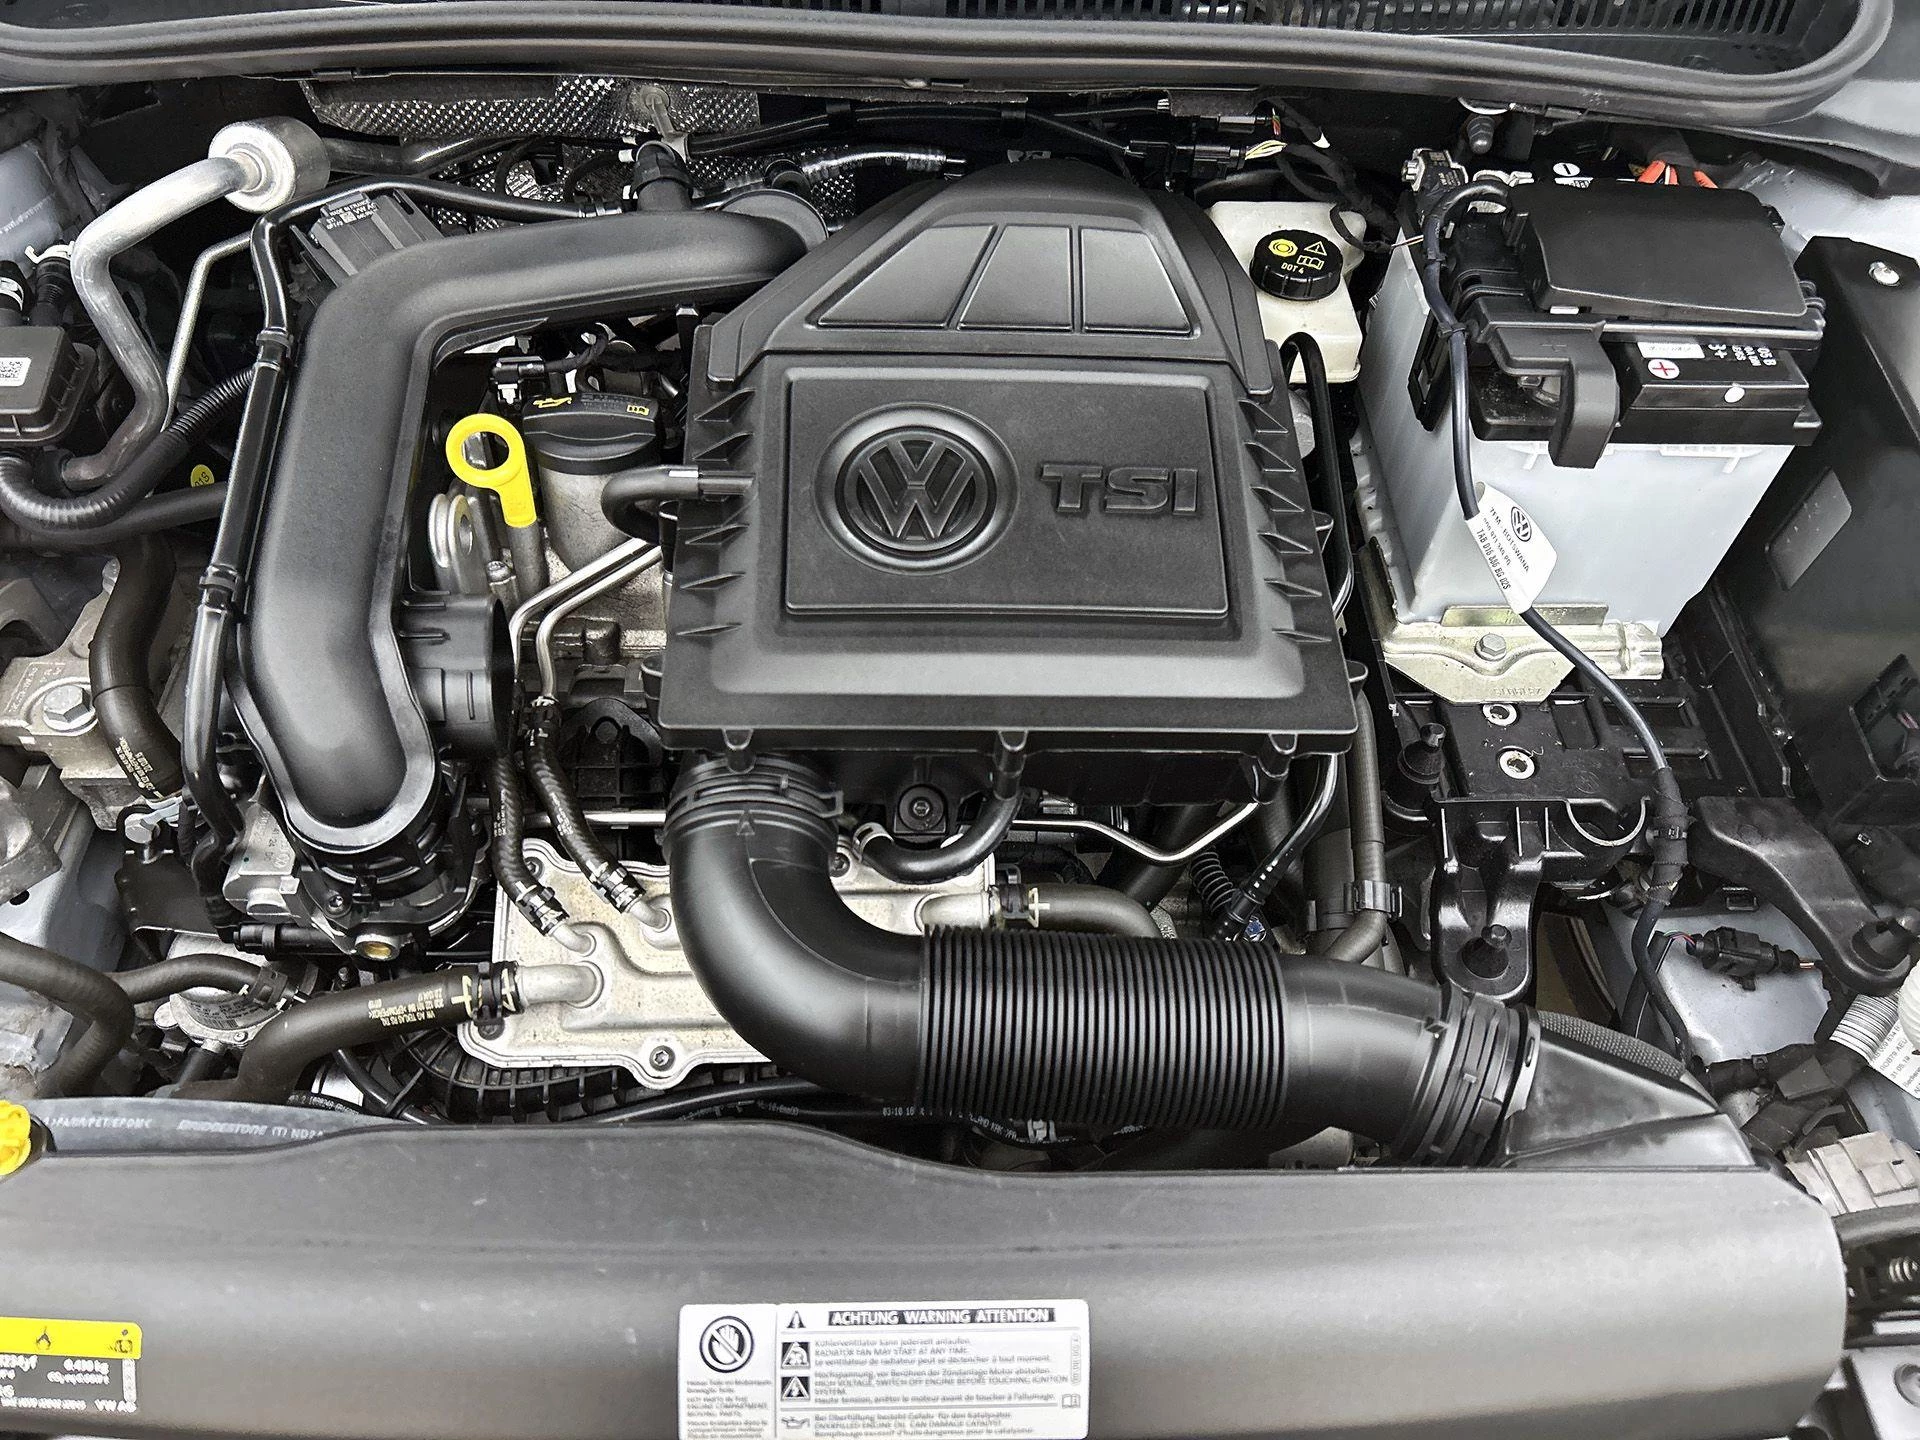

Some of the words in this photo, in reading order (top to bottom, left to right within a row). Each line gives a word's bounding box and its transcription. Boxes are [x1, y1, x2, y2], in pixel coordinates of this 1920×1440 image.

[1281, 262, 1298, 272] DOT
[1041, 462, 1200, 515] TSI
[830, 1310, 899, 1326] ACHTUNG
[903, 1309, 971, 1324] WARNING
[975, 1308, 1050, 1323] ATTENTION
